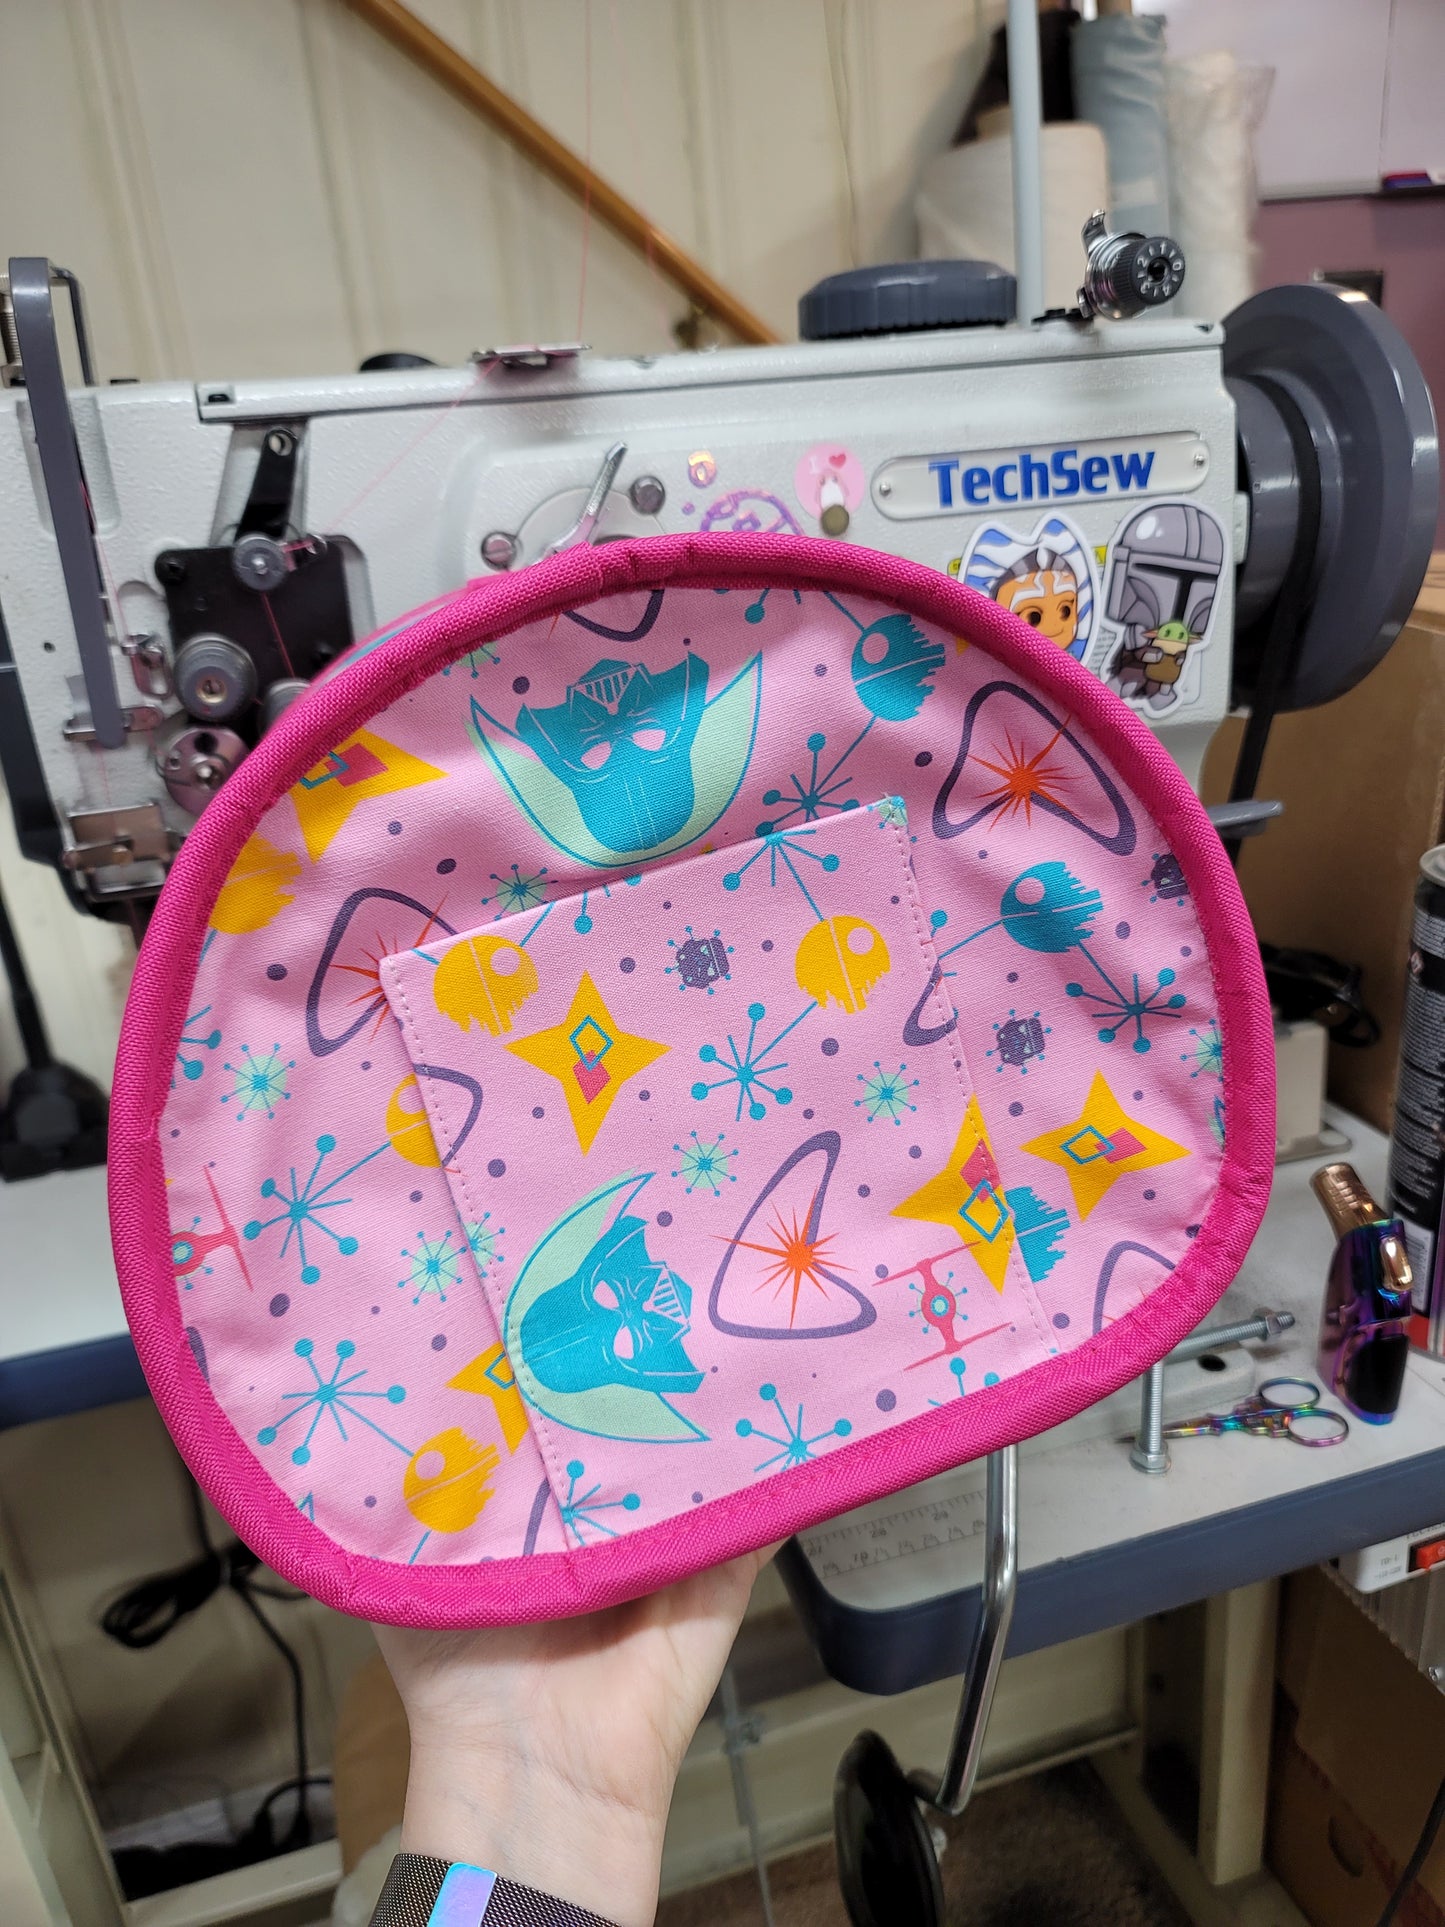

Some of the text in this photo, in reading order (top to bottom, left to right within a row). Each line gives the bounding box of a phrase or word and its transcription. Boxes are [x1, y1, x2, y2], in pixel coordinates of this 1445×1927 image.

[1160, 241, 1167, 255] 1
[1137, 256, 1148, 268] 2
[1172, 260, 1182, 271] 0
[1140, 281, 1150, 294] 3
[1162, 283, 1170, 297] 4
[928, 450, 1156, 509] TechSew
